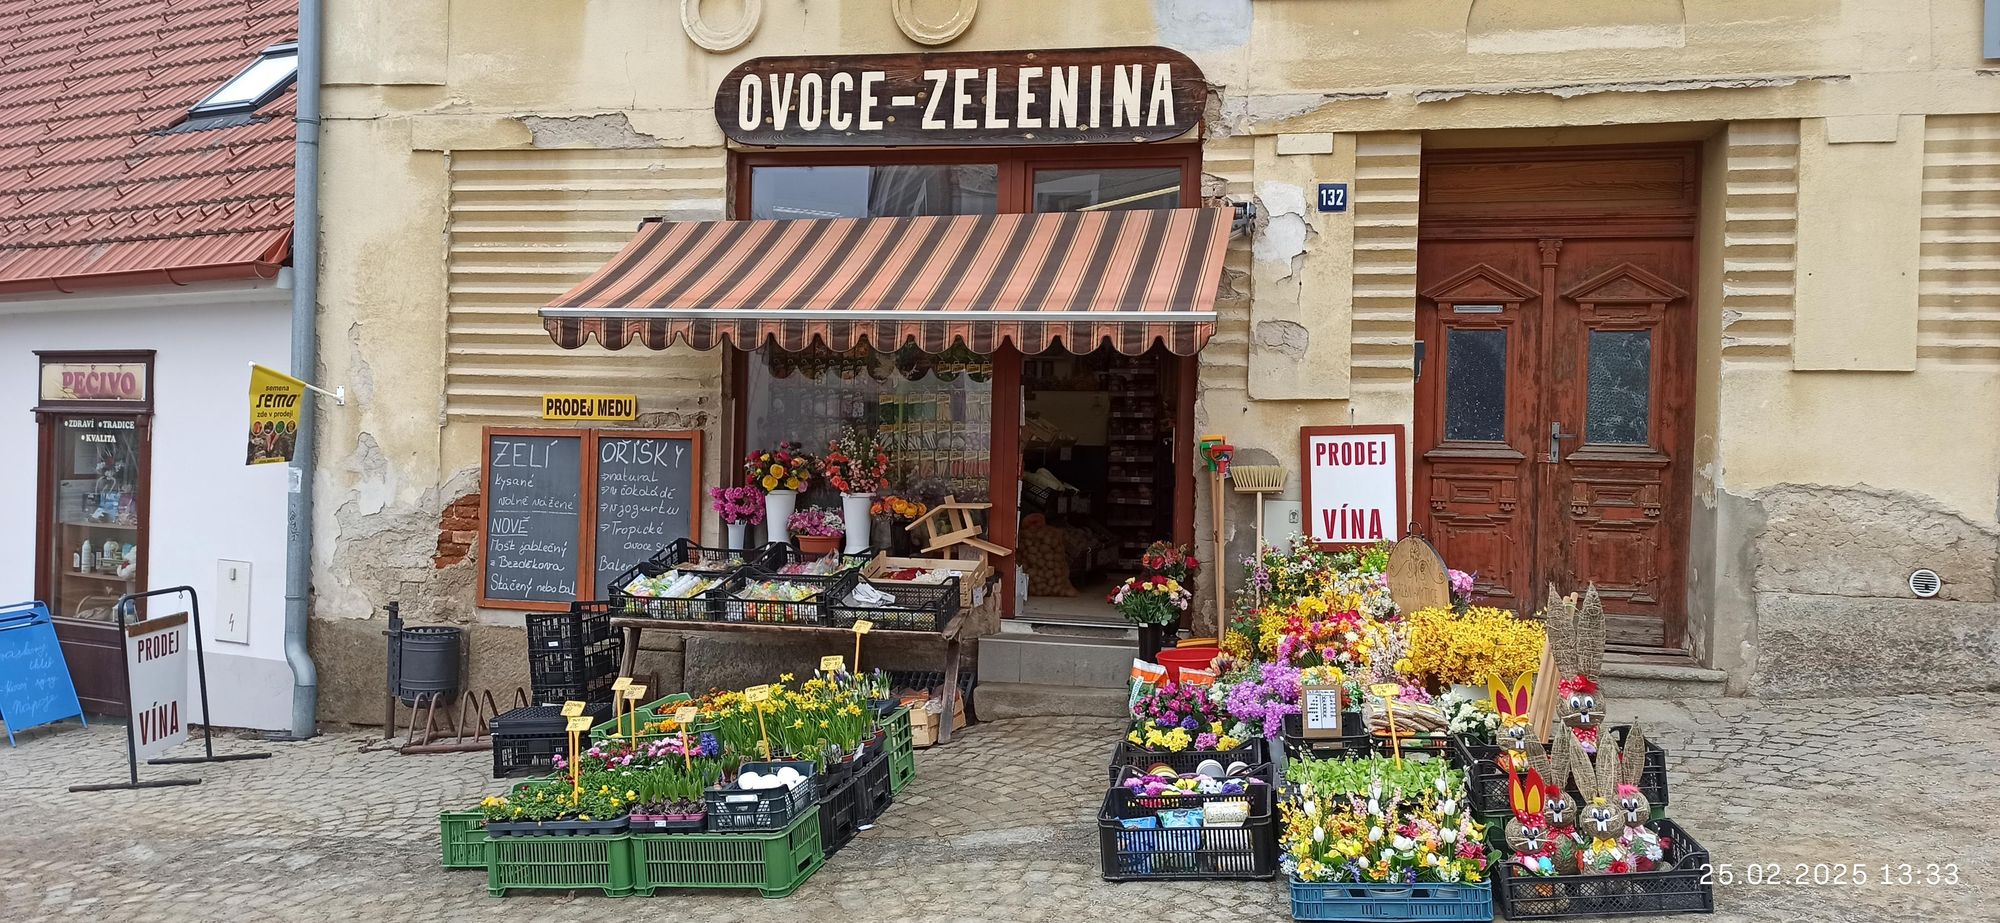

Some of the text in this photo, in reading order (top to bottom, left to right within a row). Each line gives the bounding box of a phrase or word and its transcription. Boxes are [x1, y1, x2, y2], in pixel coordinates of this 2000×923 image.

[738, 63, 1176, 131] OVOCE-ZELENINA
[1320, 188, 1344, 207] 132
[62, 366, 136, 395] PEČIVO
[546, 398, 632, 417] PRODEJ MEDU
[69, 418, 135, 430] ZDRAVÍ TRADICE
[85, 434, 117, 443] KVALITA
[492, 439, 558, 469] ZELÍ
[601, 439, 684, 469] OŘÍŠKY
[1315, 440, 1387, 467] PRODEJ
[494, 473, 535, 491] kysané
[609, 467, 659, 482] natural
[611, 520, 664, 540] Tropické
[1322, 503, 1384, 540] VÍNA
[518, 540, 568, 558] jablečný
[623, 541, 652, 552] ovoce
[498, 555, 566, 571] Bezděkova
[598, 555, 641, 571] Balen
[489, 573, 577, 599] Stáčený nebo bal
[137, 630, 180, 664] PRODEJ
[138, 700, 180, 746] VÍNA
